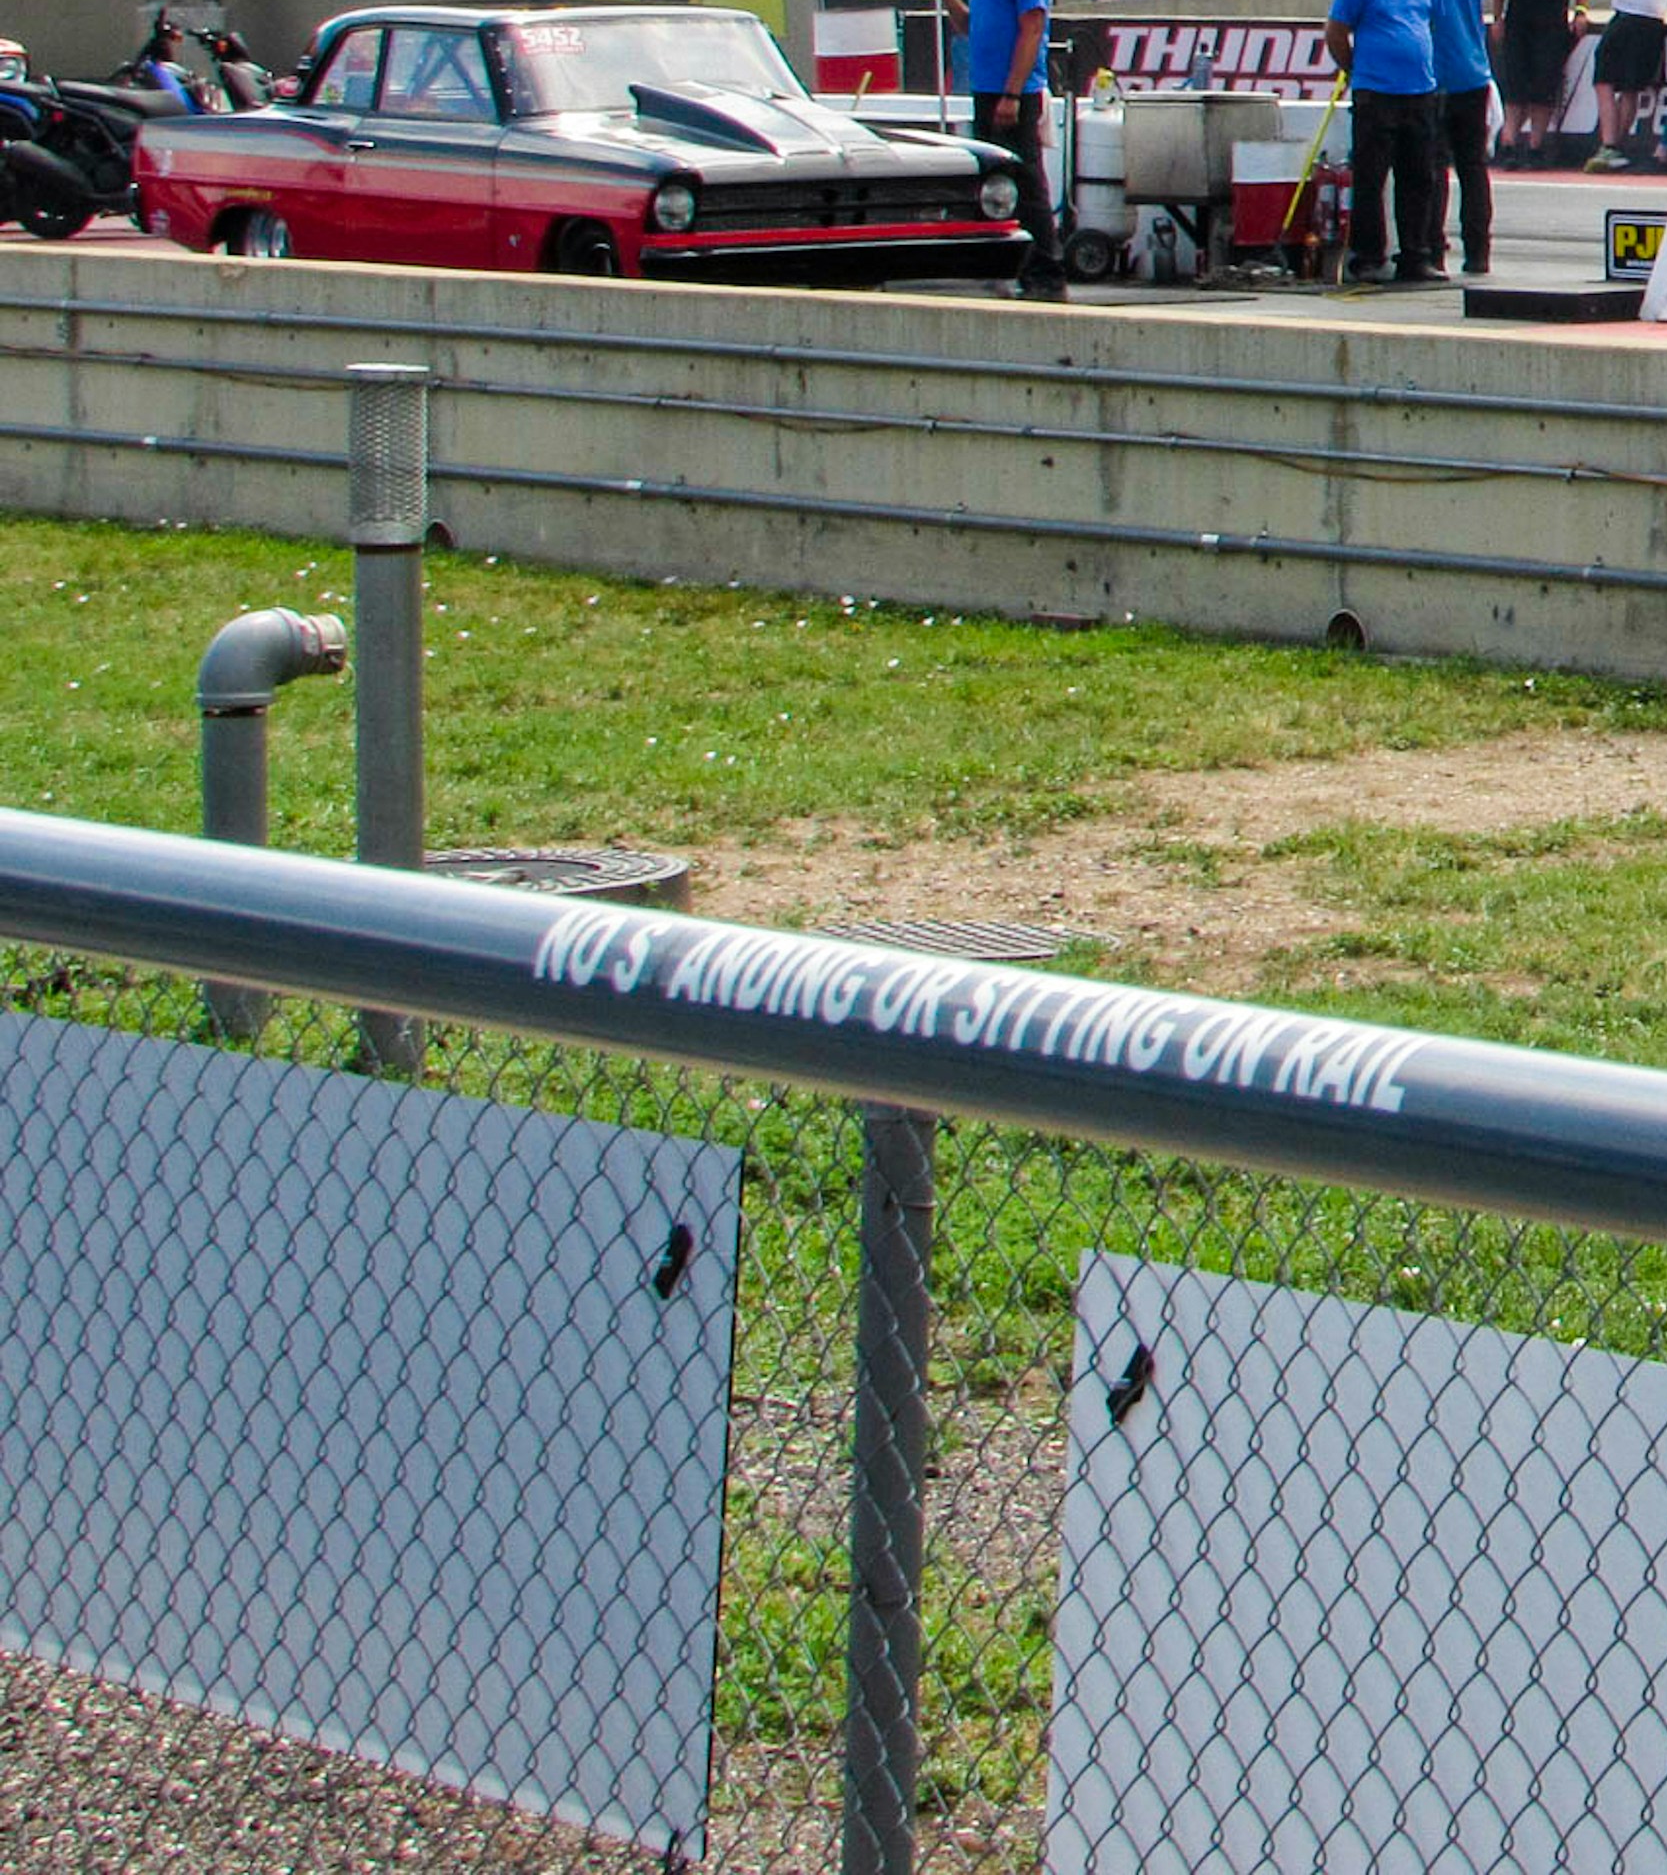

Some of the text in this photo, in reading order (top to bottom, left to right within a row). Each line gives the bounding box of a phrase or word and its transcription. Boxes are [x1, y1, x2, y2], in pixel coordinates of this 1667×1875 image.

[534, 908, 629, 987] NO
[871, 950, 968, 1039] OR
[955, 976, 1180, 1073] SITTING
[1183, 1002, 1282, 1094] ON
[1283, 1018, 1428, 1113] RAIL
